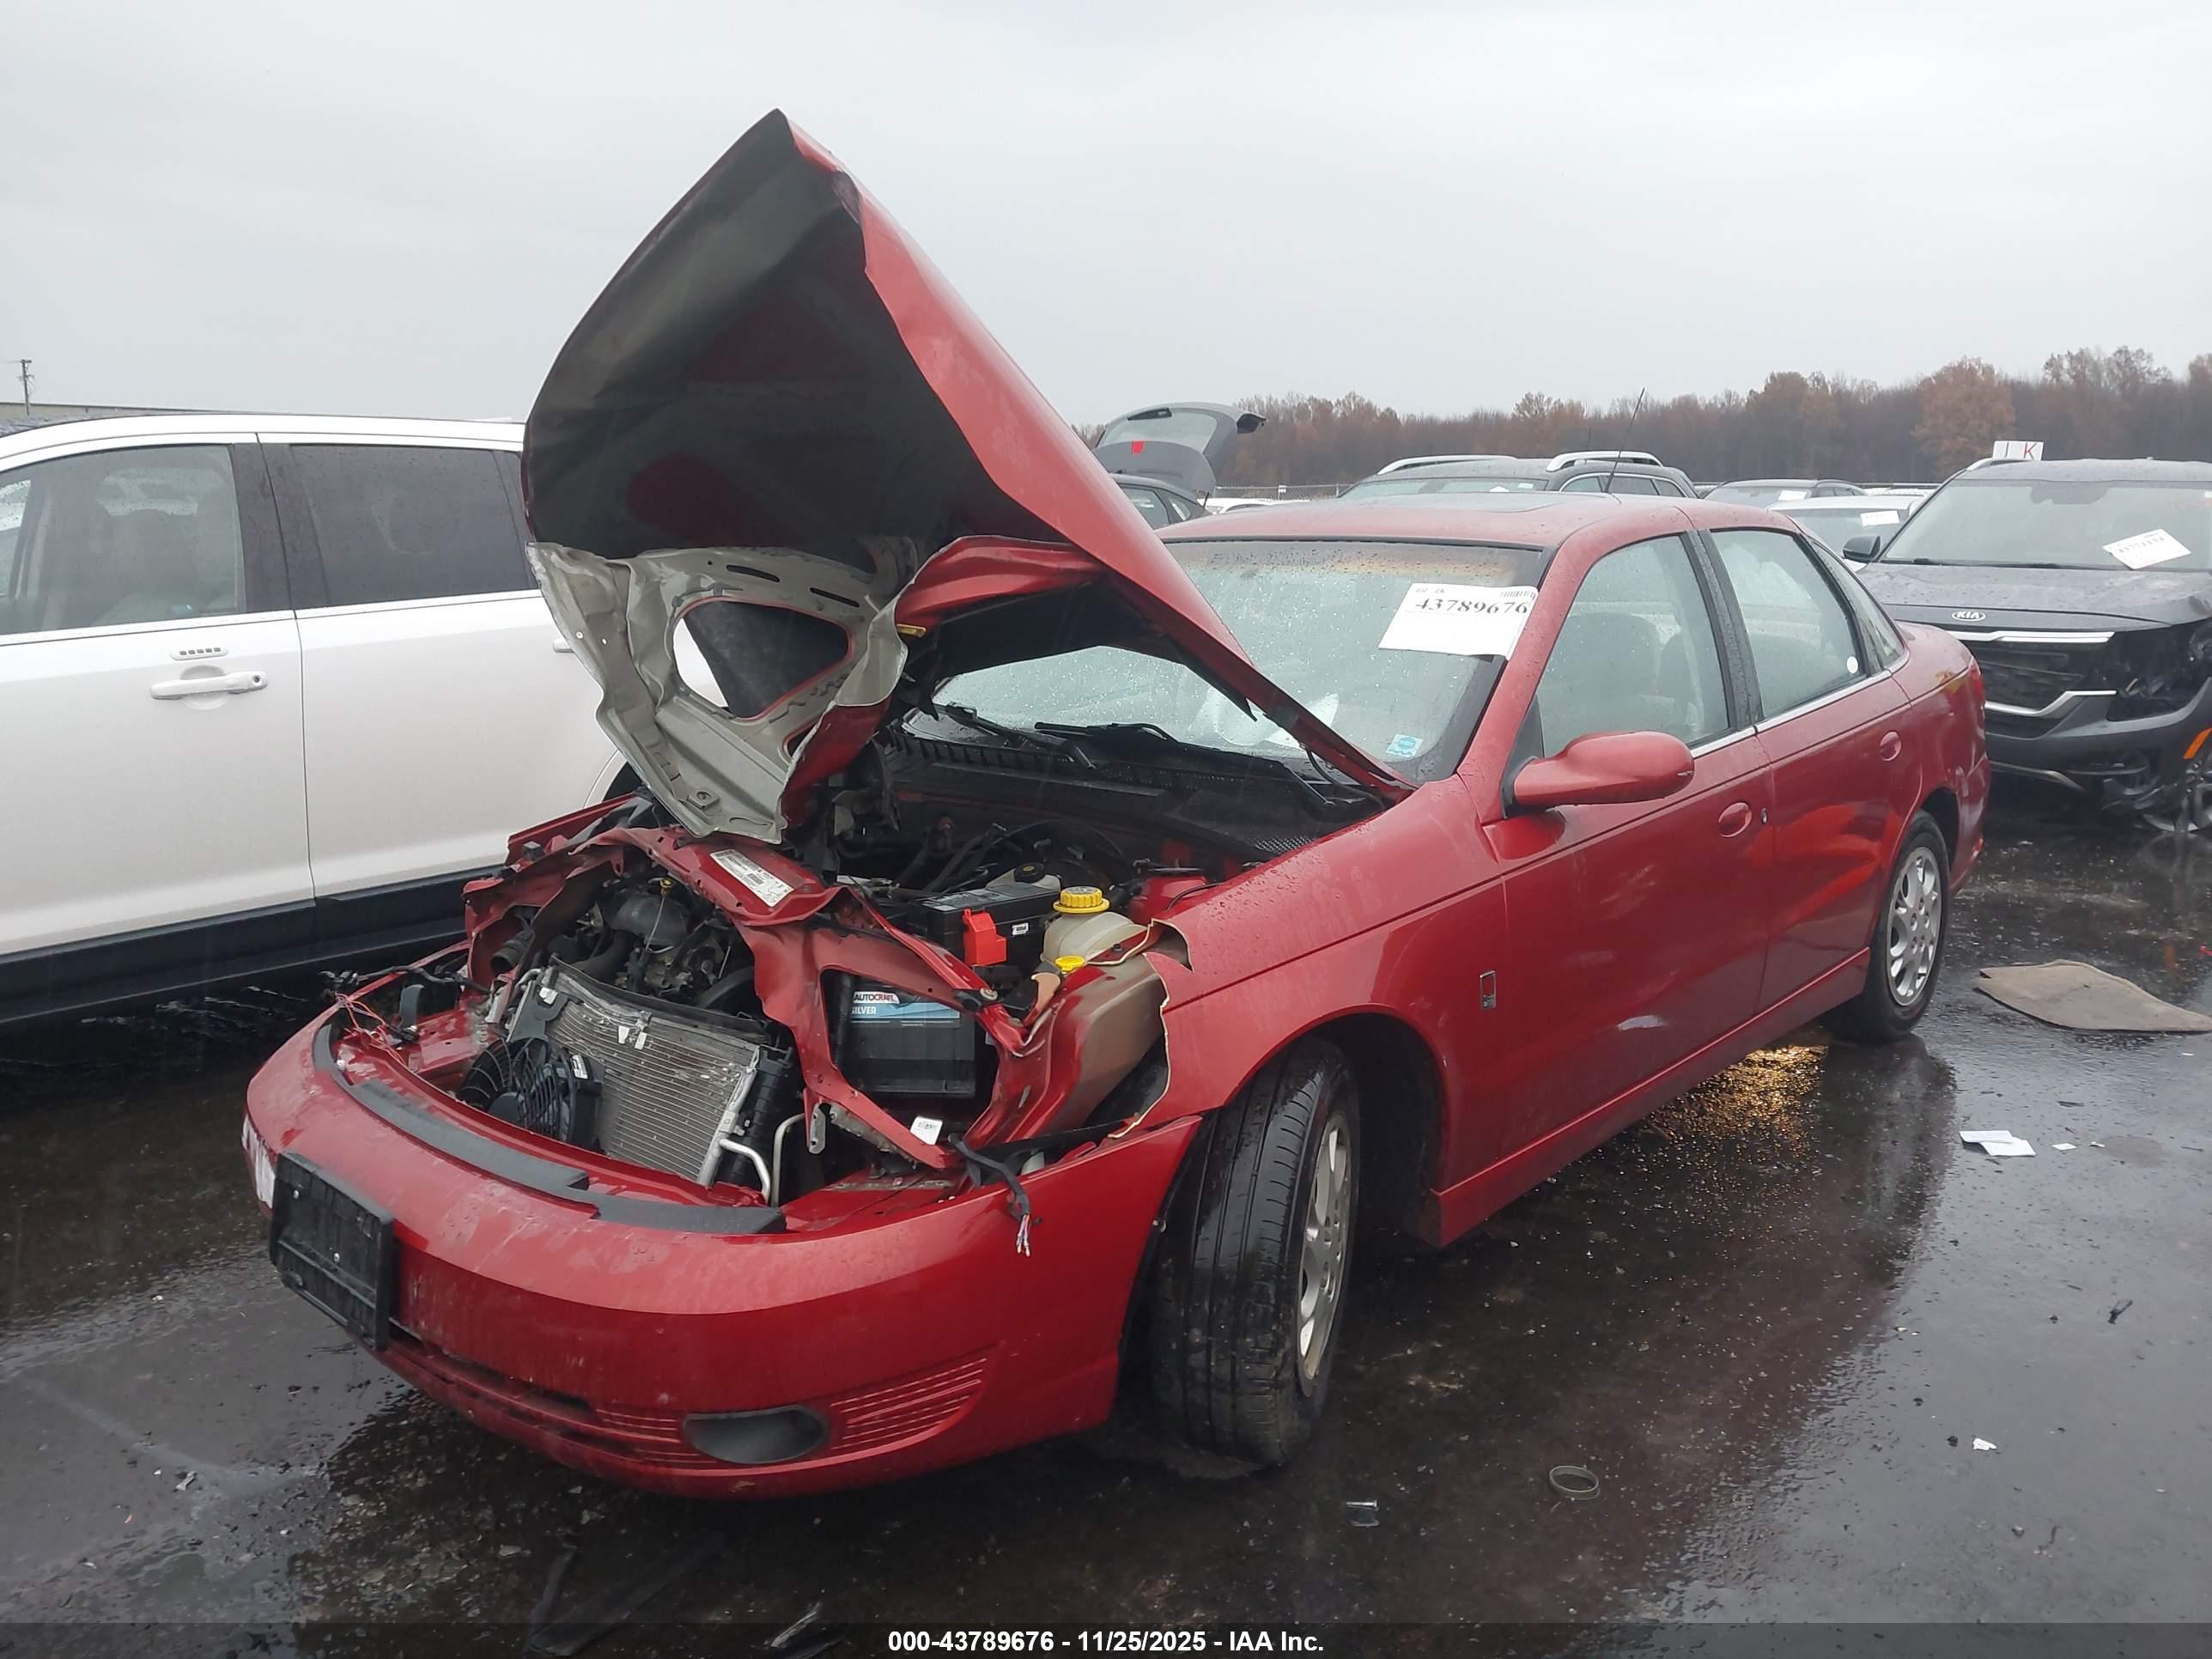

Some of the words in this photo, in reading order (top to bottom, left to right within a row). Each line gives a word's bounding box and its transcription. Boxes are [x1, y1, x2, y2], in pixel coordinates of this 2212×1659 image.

[2023, 441, 2038, 461] K
[1414, 598, 1529, 614] 43789676
[1956, 611, 1981, 619] KIA
[851, 1006, 877, 1015] SILVER
